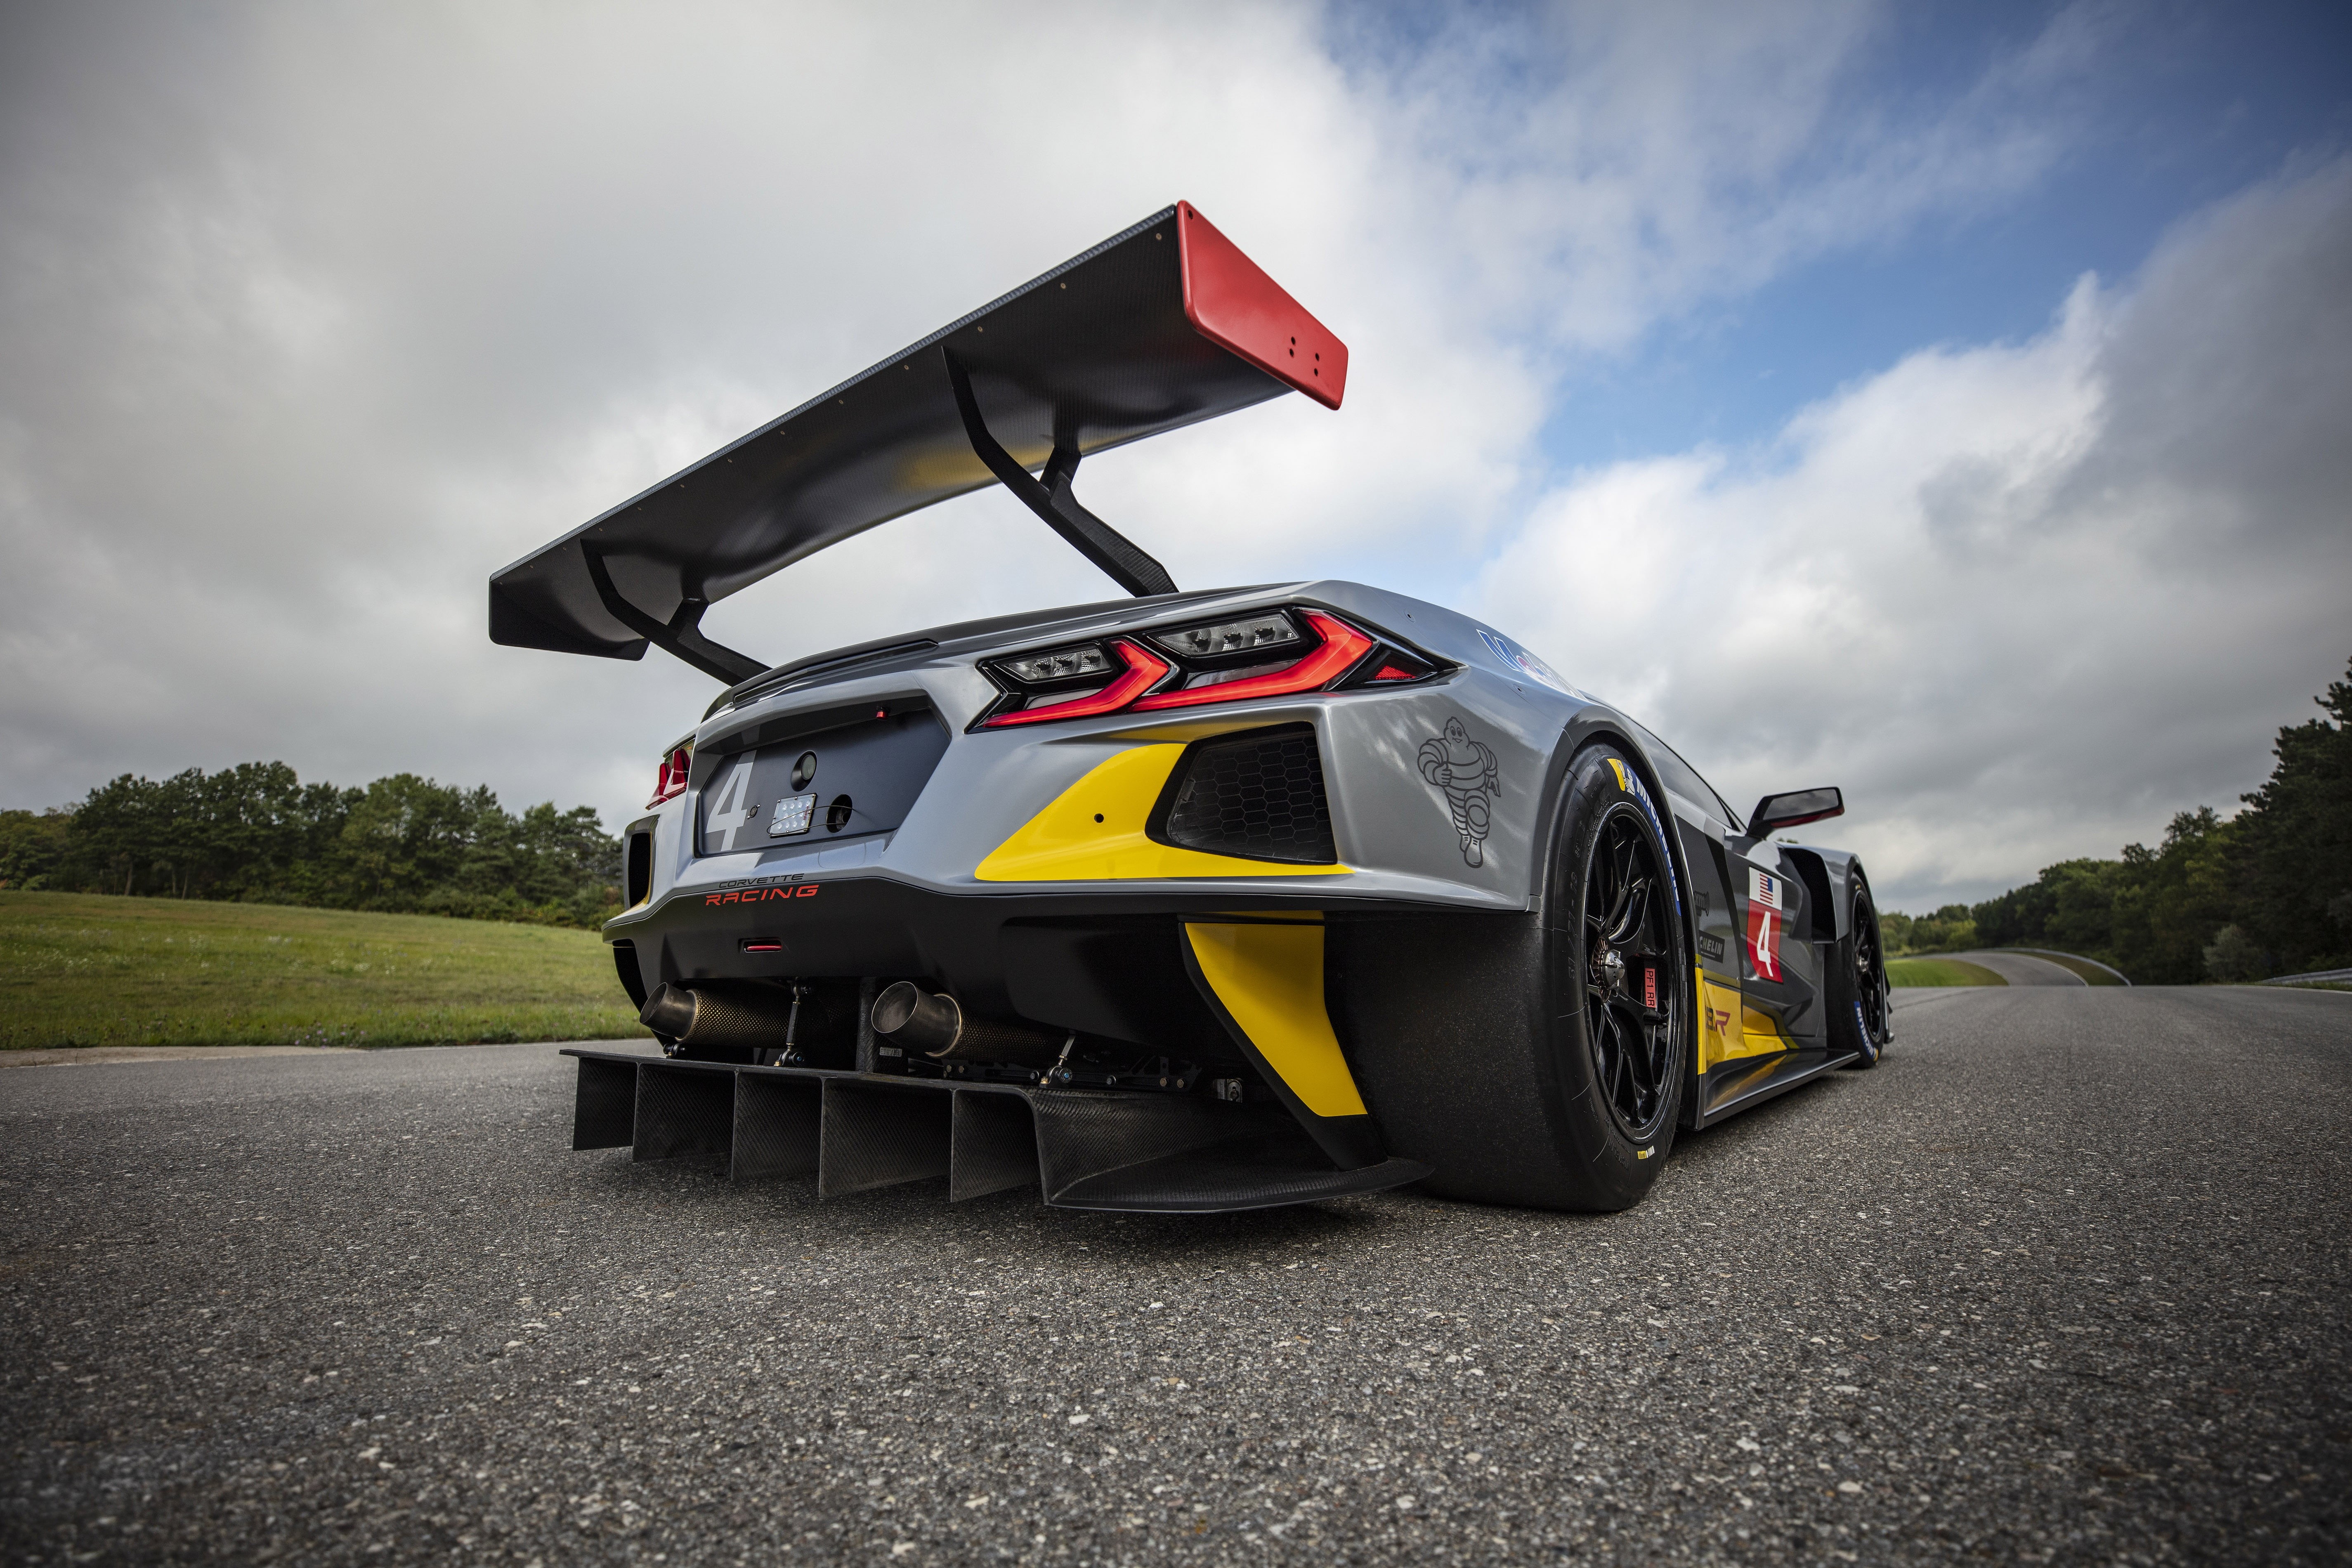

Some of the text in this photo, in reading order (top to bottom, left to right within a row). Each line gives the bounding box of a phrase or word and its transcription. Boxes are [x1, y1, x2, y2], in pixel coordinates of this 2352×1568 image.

[705, 750, 757, 852] 4
[1636, 776, 1679, 901] MICHELIN
[719, 873, 804, 888] CORVETTE
[706, 885, 819, 906] RACING
[1700, 936, 1723, 955] CHELIN
[1757, 911, 1773, 977] 4
[1647, 992, 1655, 1006] RR
[1706, 1007, 1731, 1036] 8.R
[1856, 1007, 1874, 1056] MICHELIN
